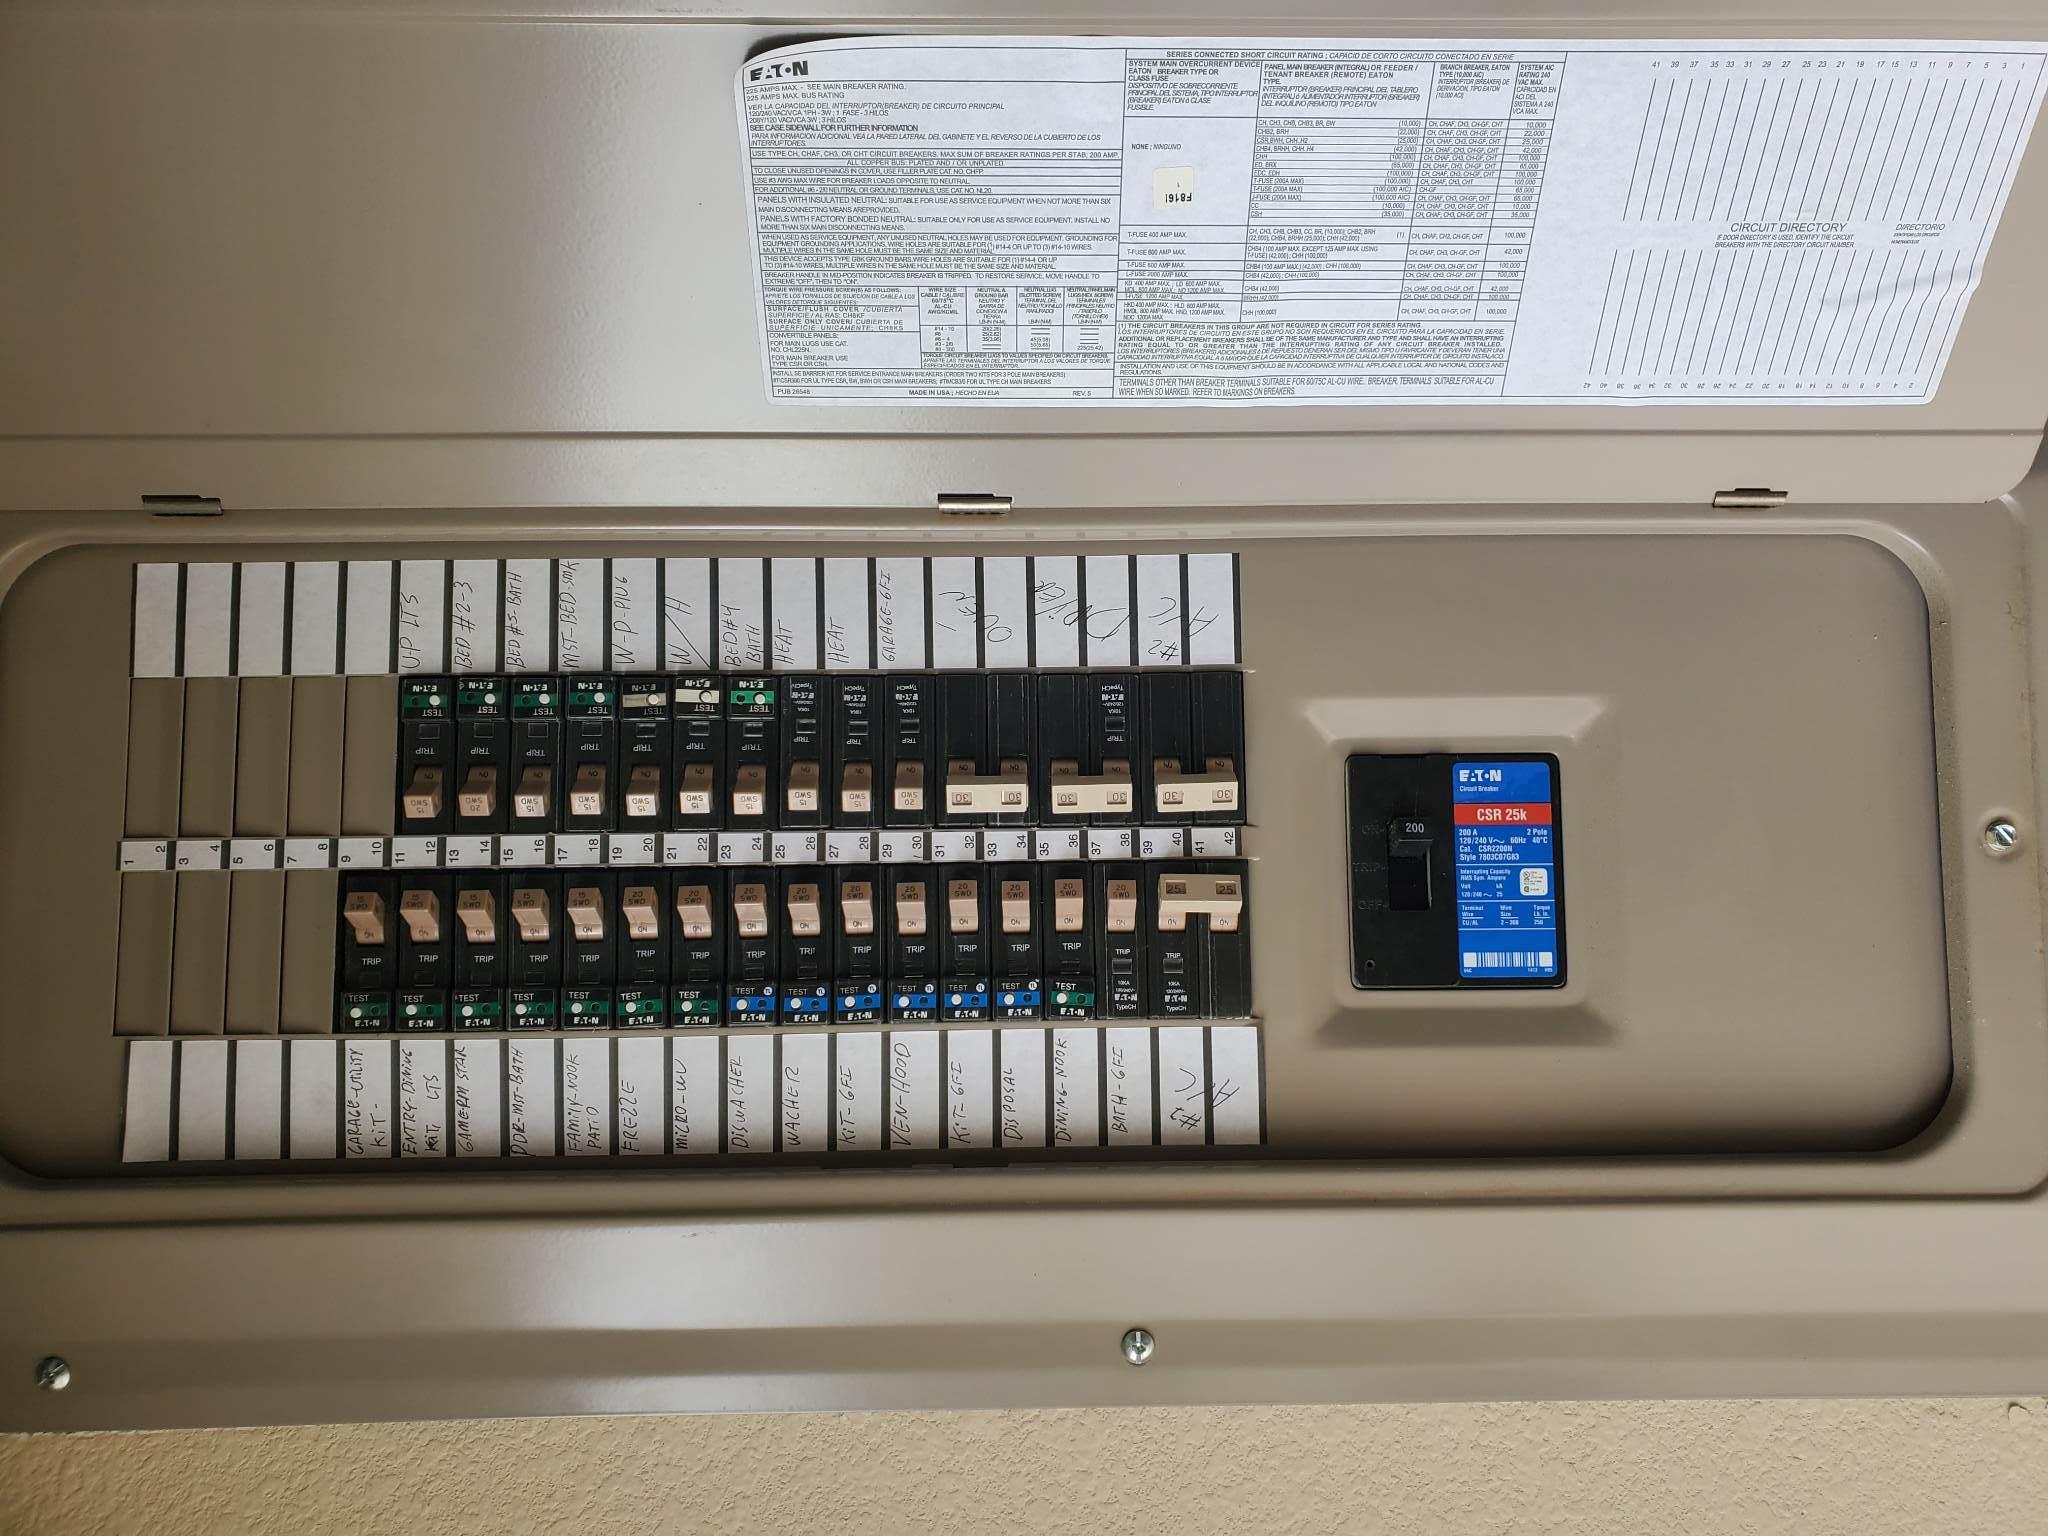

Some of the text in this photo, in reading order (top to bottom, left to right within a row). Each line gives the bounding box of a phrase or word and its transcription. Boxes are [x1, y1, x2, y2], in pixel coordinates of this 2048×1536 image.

[749, 60, 809, 82] EATON
[1731, 223, 1847, 232] CIRCUIT DIRECTORY
[744, 623, 764, 664] BATH
[771, 616, 794, 667] HEAT
[825, 616, 849, 663] HEAT
[454, 637, 472, 669] BED
[506, 634, 526, 668] BED
[1148, 640, 1178, 661] #2
[1460, 770, 1501, 781] EATON
[1477, 809, 1526, 820] CSR 25k
[1406, 823, 1424, 832] 200
[589, 839, 598, 851] 18
[643, 838, 653, 851] 20
[698, 838, 707, 851] 22
[752, 837, 761, 850] 24
[806, 837, 815, 850] 26
[859, 837, 868, 849] 28
[912, 836, 921, 849] 30
[965, 836, 974, 848] 32
[1017, 835, 1026, 848] 34
[1069, 834, 1078, 847] 36
[1120, 834, 1129, 846] 38
[1172, 833, 1181, 845] 40
[1225, 832, 1233, 845] 42
[372, 842, 381, 854] 10
[426, 841, 435, 854] 12
[480, 841, 490, 853] 14
[534, 840, 544, 852] 16
[721, 845, 731, 859] 23
[775, 845, 785, 858] 25
[829, 845, 838, 858] 27
[882, 844, 892, 857] 29
[935, 846, 944, 857] 31
[987, 843, 997, 856] 33
[1040, 843, 1049, 855] 35
[1091, 842, 1100, 854] 37
[1143, 841, 1152, 854] 39
[1195, 842, 1204, 853] 41
[395, 853, 405, 863] 11
[449, 850, 459, 862] 13
[504, 849, 513, 861] 15
[558, 848, 567, 861] 17
[612, 847, 622, 860] 19
[667, 848, 676, 859] 21
